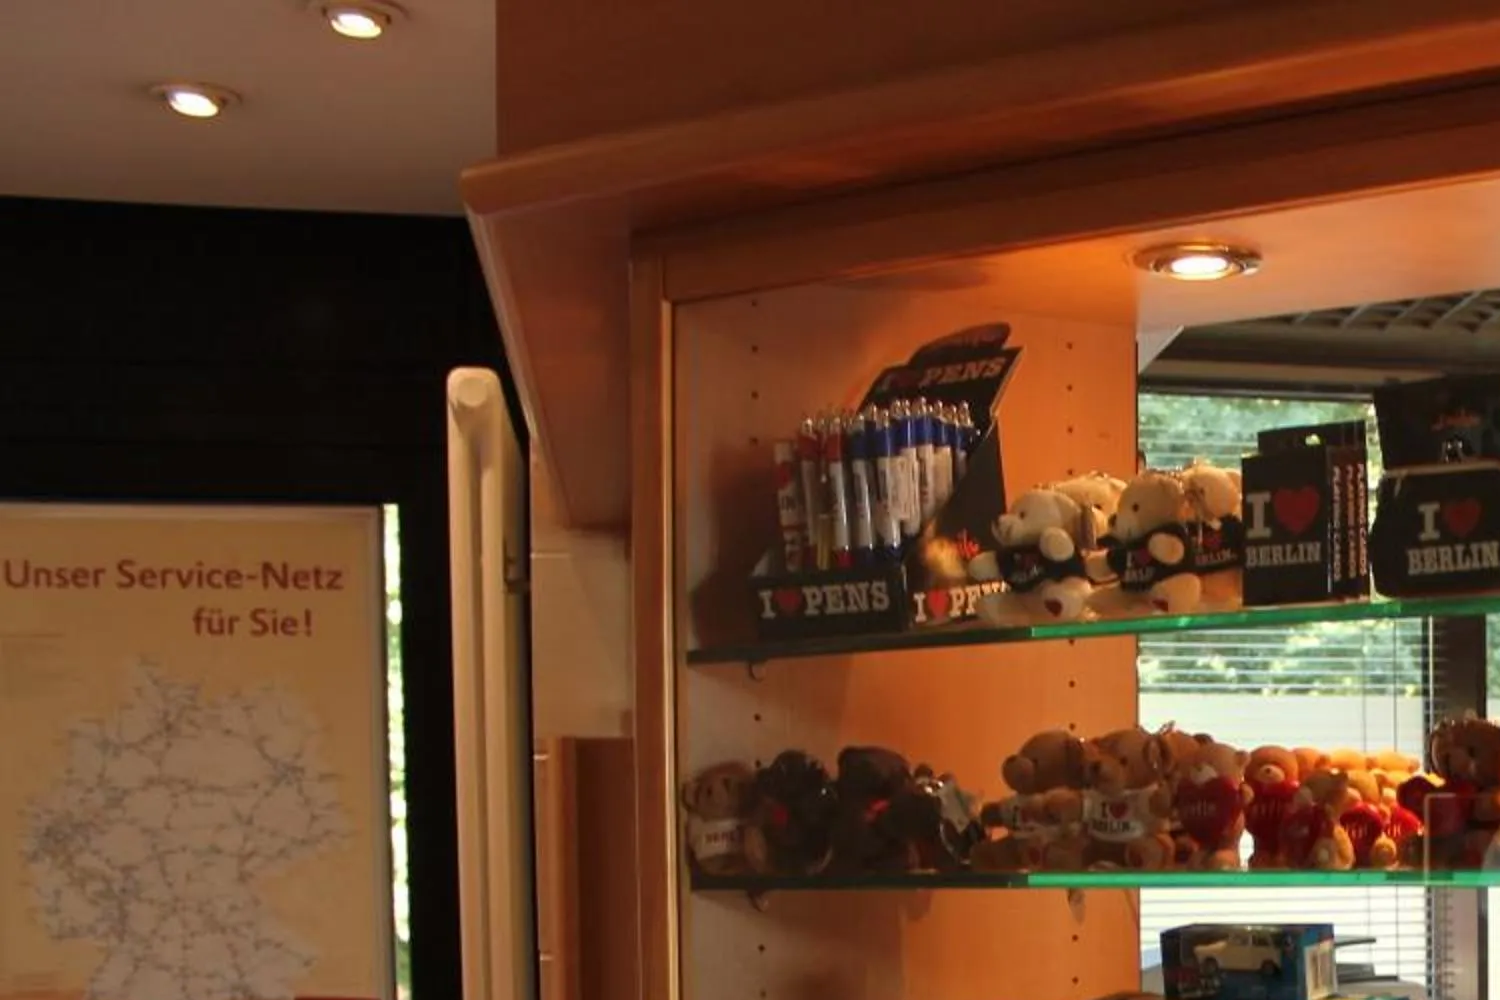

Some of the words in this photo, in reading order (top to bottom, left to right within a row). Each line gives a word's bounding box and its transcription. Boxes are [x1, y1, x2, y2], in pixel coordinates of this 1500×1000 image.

[1416, 501, 1441, 542] I
[1245, 541, 1322, 568] BERLIN
[1406, 540, 1500, 577] BERLIN
[3, 559, 106, 589] Unser
[115, 560, 346, 590] Service-Netz
[758, 589, 776, 620] I
[802, 580, 891, 617] PENS
[192, 606, 240, 636] für
[249, 608, 313, 637] Sie!
